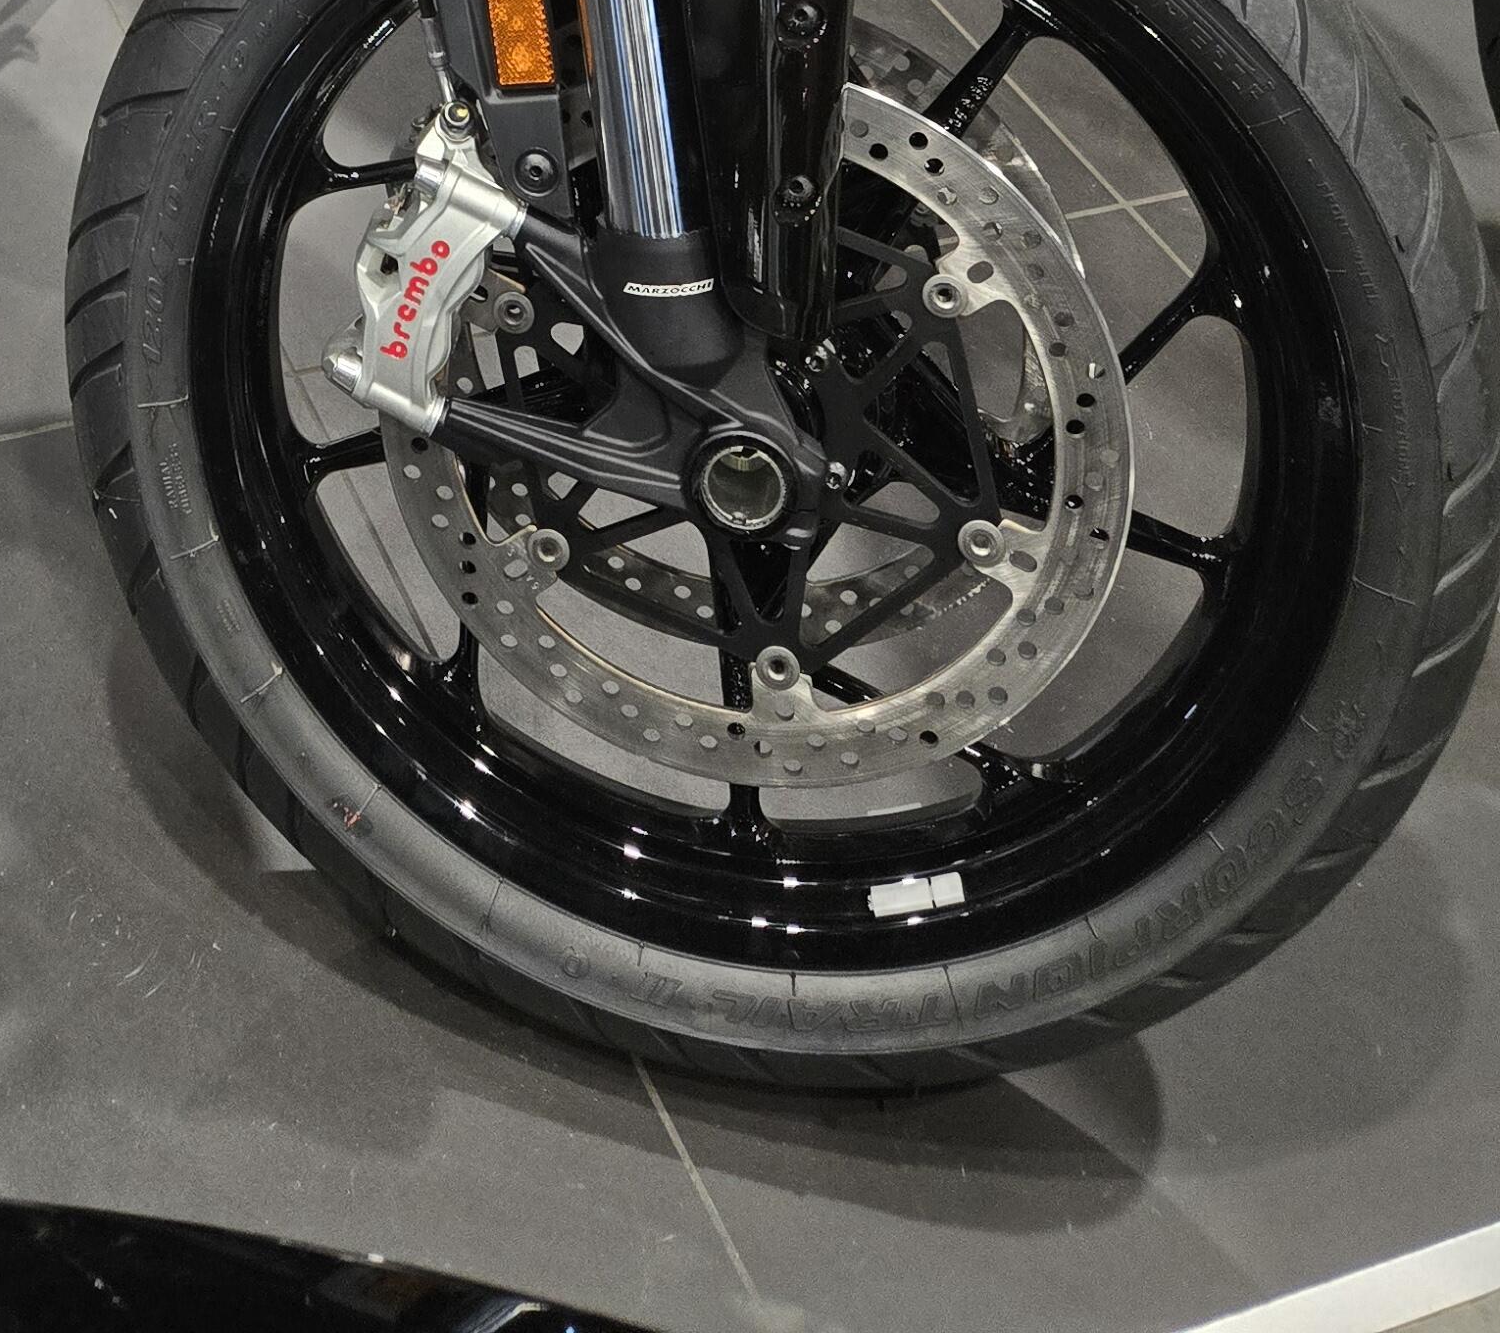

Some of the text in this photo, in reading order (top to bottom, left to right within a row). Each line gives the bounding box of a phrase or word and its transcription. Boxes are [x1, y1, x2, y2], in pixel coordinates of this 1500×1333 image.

[380, 240, 451, 359] brembo
[627, 281, 712, 294] MARZOCCHI
[974, 767, 1324, 1023] SCORPION
[712, 986, 952, 1035] TRAIL
